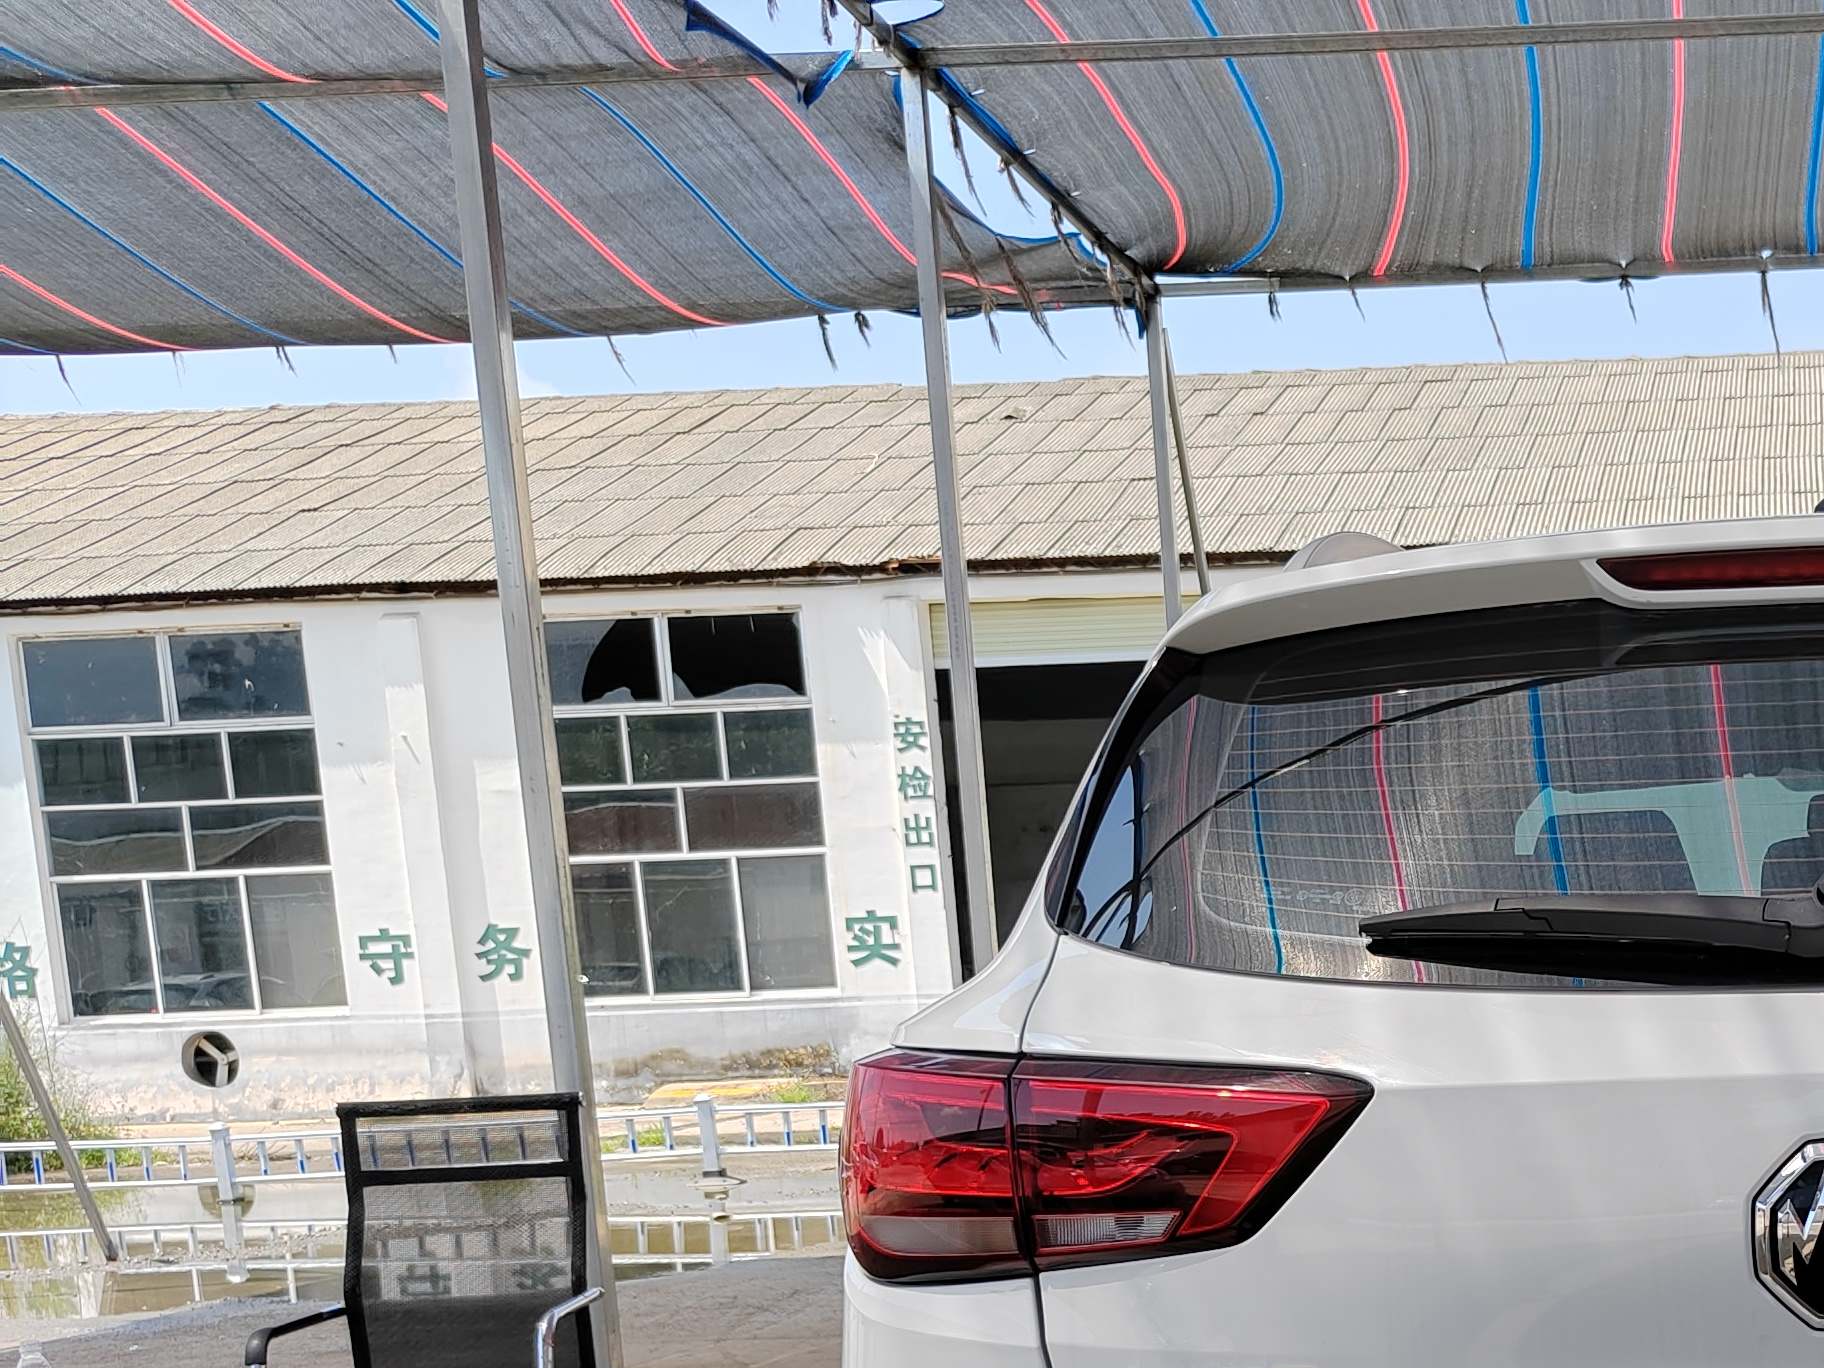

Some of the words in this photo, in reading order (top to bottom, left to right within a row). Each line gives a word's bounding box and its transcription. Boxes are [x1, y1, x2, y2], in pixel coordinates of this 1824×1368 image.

[893, 715, 939, 893] 安检出口
[358, 928, 415, 986] 守
[474, 923, 532, 983] 务
[845, 910, 902, 968] 实
